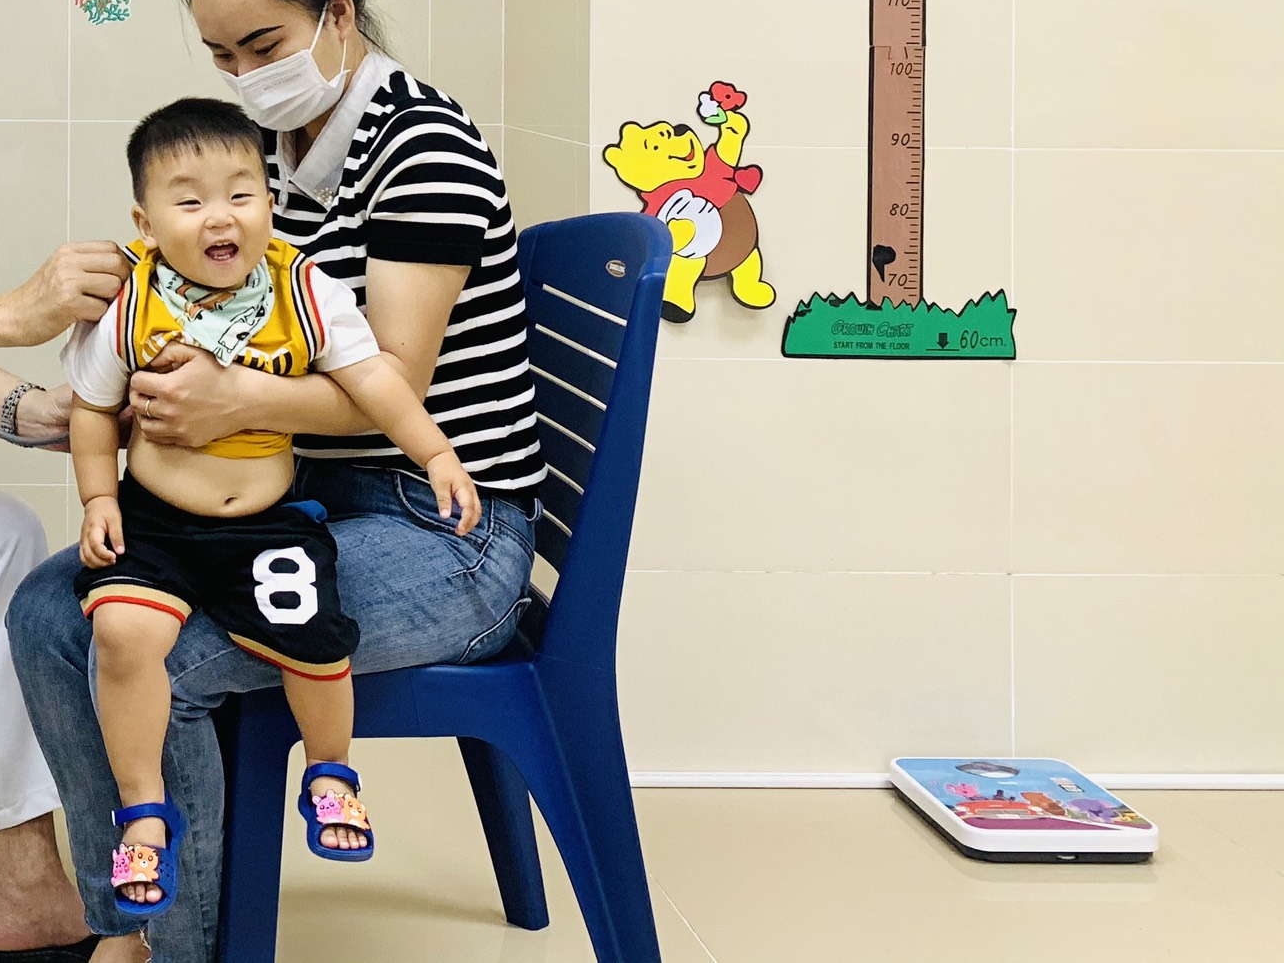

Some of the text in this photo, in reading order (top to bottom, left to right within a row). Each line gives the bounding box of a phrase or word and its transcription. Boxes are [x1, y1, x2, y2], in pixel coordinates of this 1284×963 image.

[890, 62, 913, 76] 100
[891, 133, 911, 146] 90
[889, 203, 909, 216] 80
[888, 273, 908, 287] 70
[833, 341, 910, 350] START FROM THE FLOOR
[252, 546, 318, 625] 8
